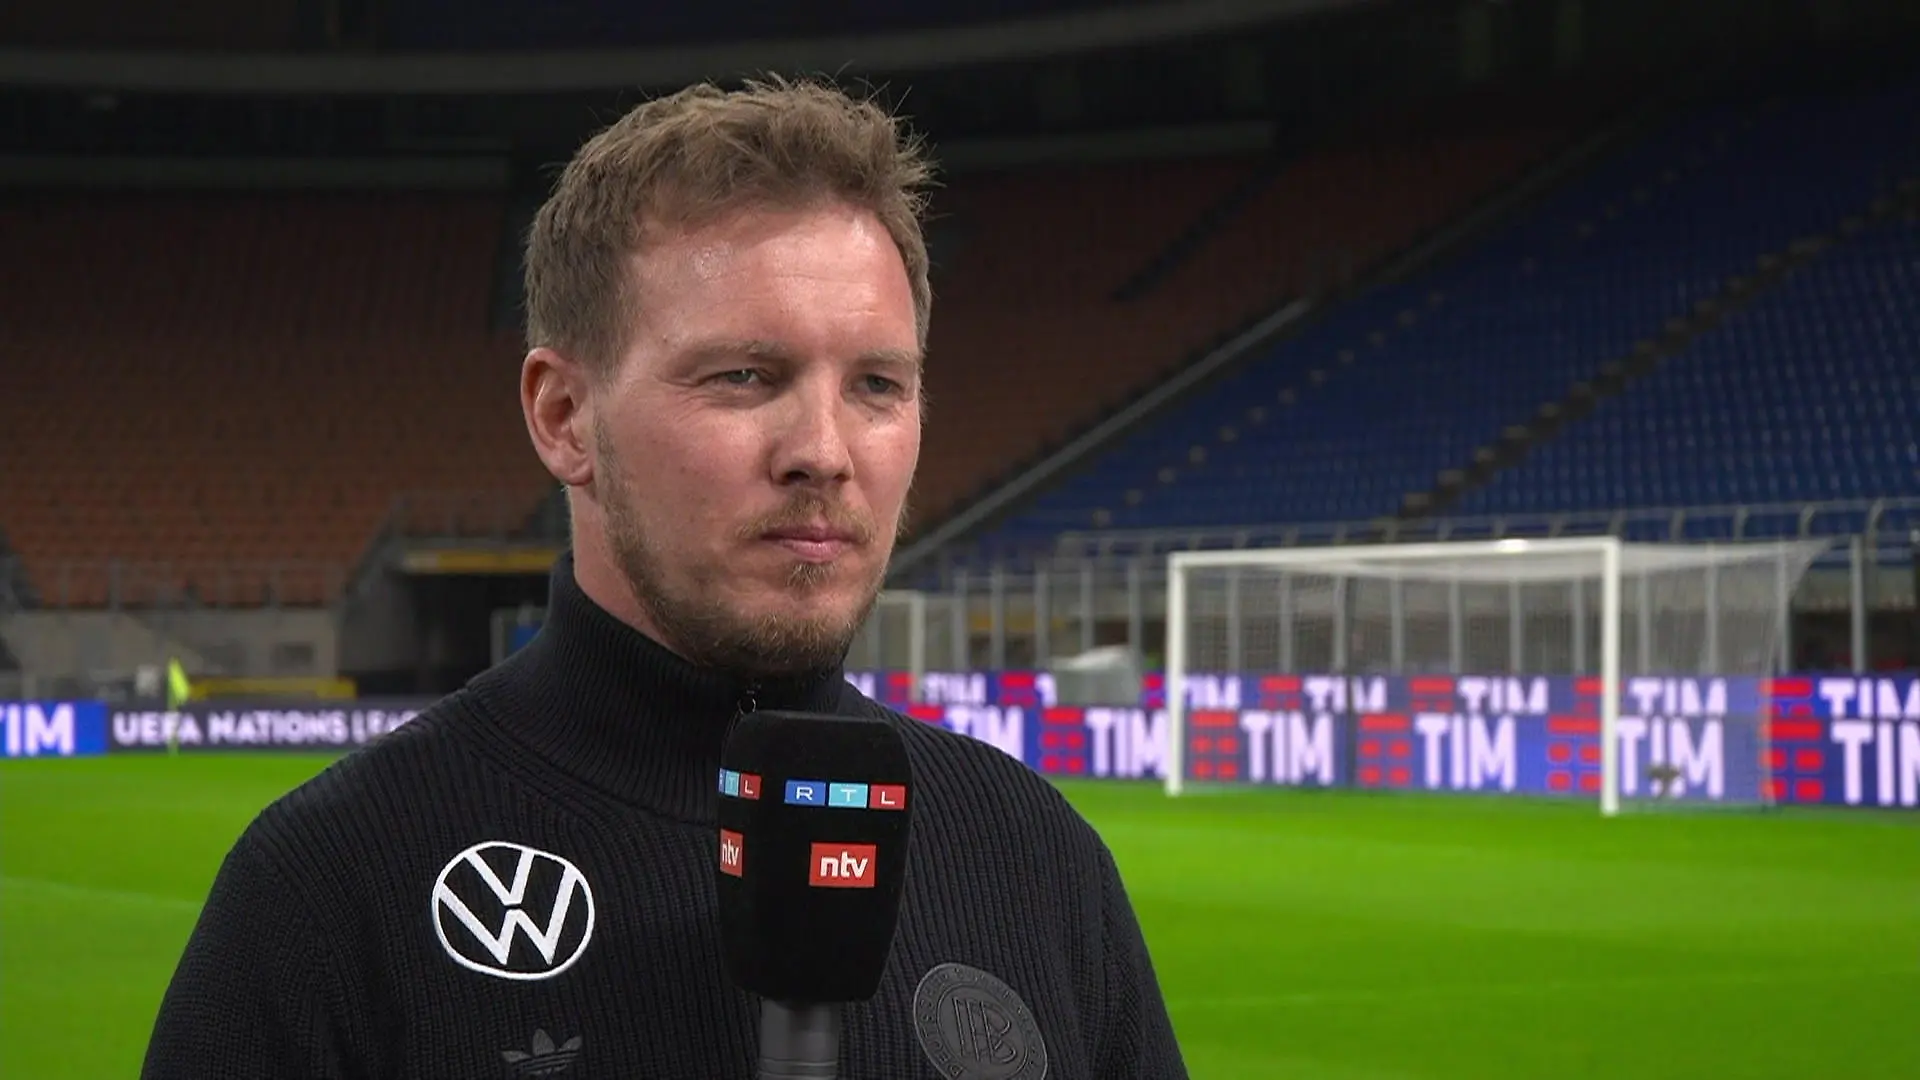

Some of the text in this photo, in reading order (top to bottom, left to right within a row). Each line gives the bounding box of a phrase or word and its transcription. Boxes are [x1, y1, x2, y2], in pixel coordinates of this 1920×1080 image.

[1629, 677, 1727, 715] TIM
[0, 702, 75, 758] IM
[112, 711, 202, 746] UEFA
[207, 710, 349, 745] NATIONS
[1240, 710, 1334, 786] TIM
[1415, 714, 1518, 793] TIM
[1617, 716, 1724, 800] TIM
[793, 785, 898, 806] RTL
[721, 838, 740, 867] ntv
[819, 850, 868, 879] ntv
